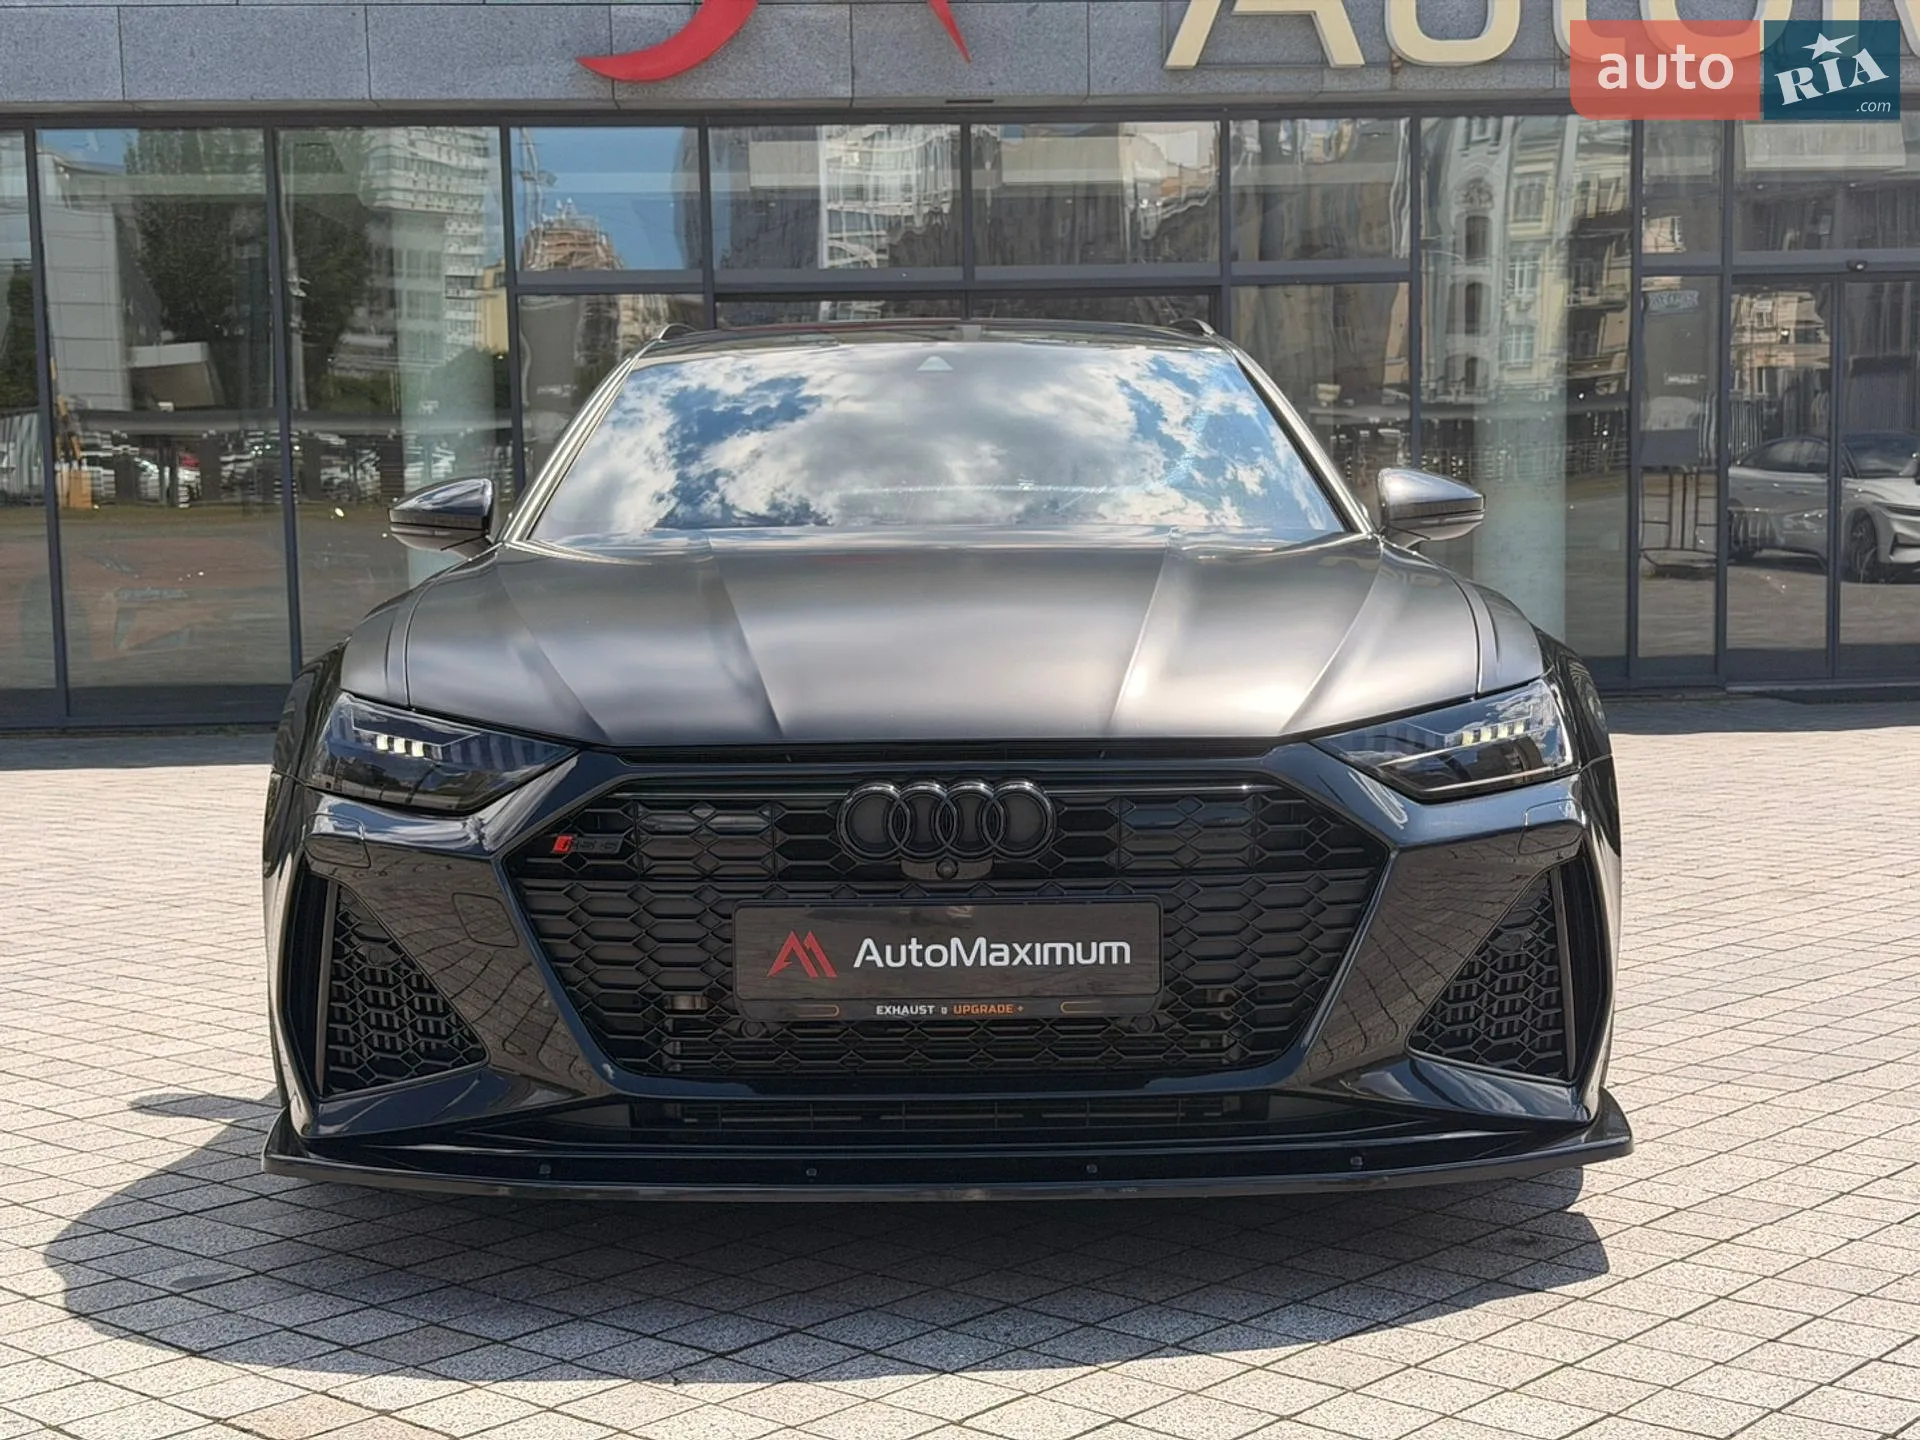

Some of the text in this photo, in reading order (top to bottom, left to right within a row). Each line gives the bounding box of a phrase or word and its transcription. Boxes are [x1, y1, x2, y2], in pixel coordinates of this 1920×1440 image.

[853, 936, 1131, 968] AutoMaximum
[875, 1004, 935, 1015] EXHAUST
[953, 1003, 1014, 1015] UPGRADE
